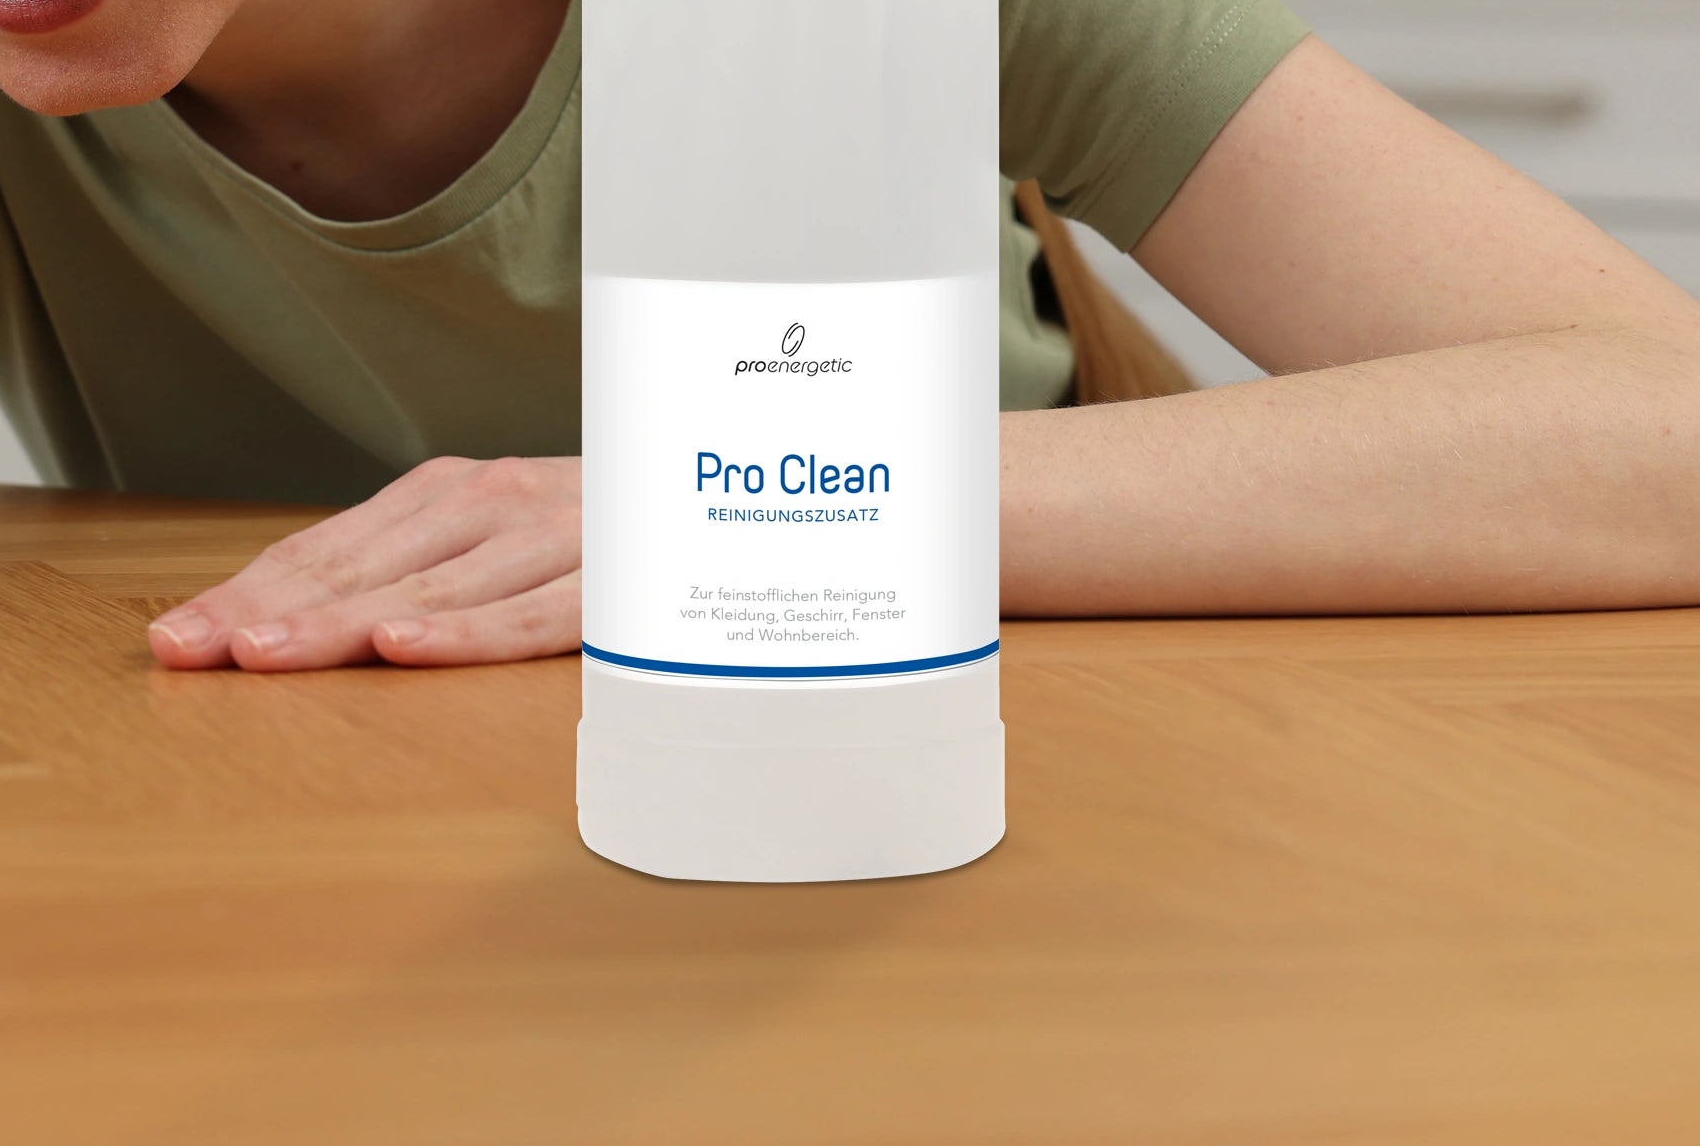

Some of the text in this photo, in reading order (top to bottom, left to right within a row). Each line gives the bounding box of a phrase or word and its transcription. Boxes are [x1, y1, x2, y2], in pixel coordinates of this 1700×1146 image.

[734, 357, 853, 377] proenergetic
[697, 452, 889, 495] Pro Clean
[708, 508, 879, 522] REINIGUNGSZUSATZ
[690, 586, 896, 604] Zur feinstofflichen Reinigung
[679, 607, 906, 624] von Kleidung, Geschirr, Fenster
[727, 628, 859, 641] und Wohnbereich.
